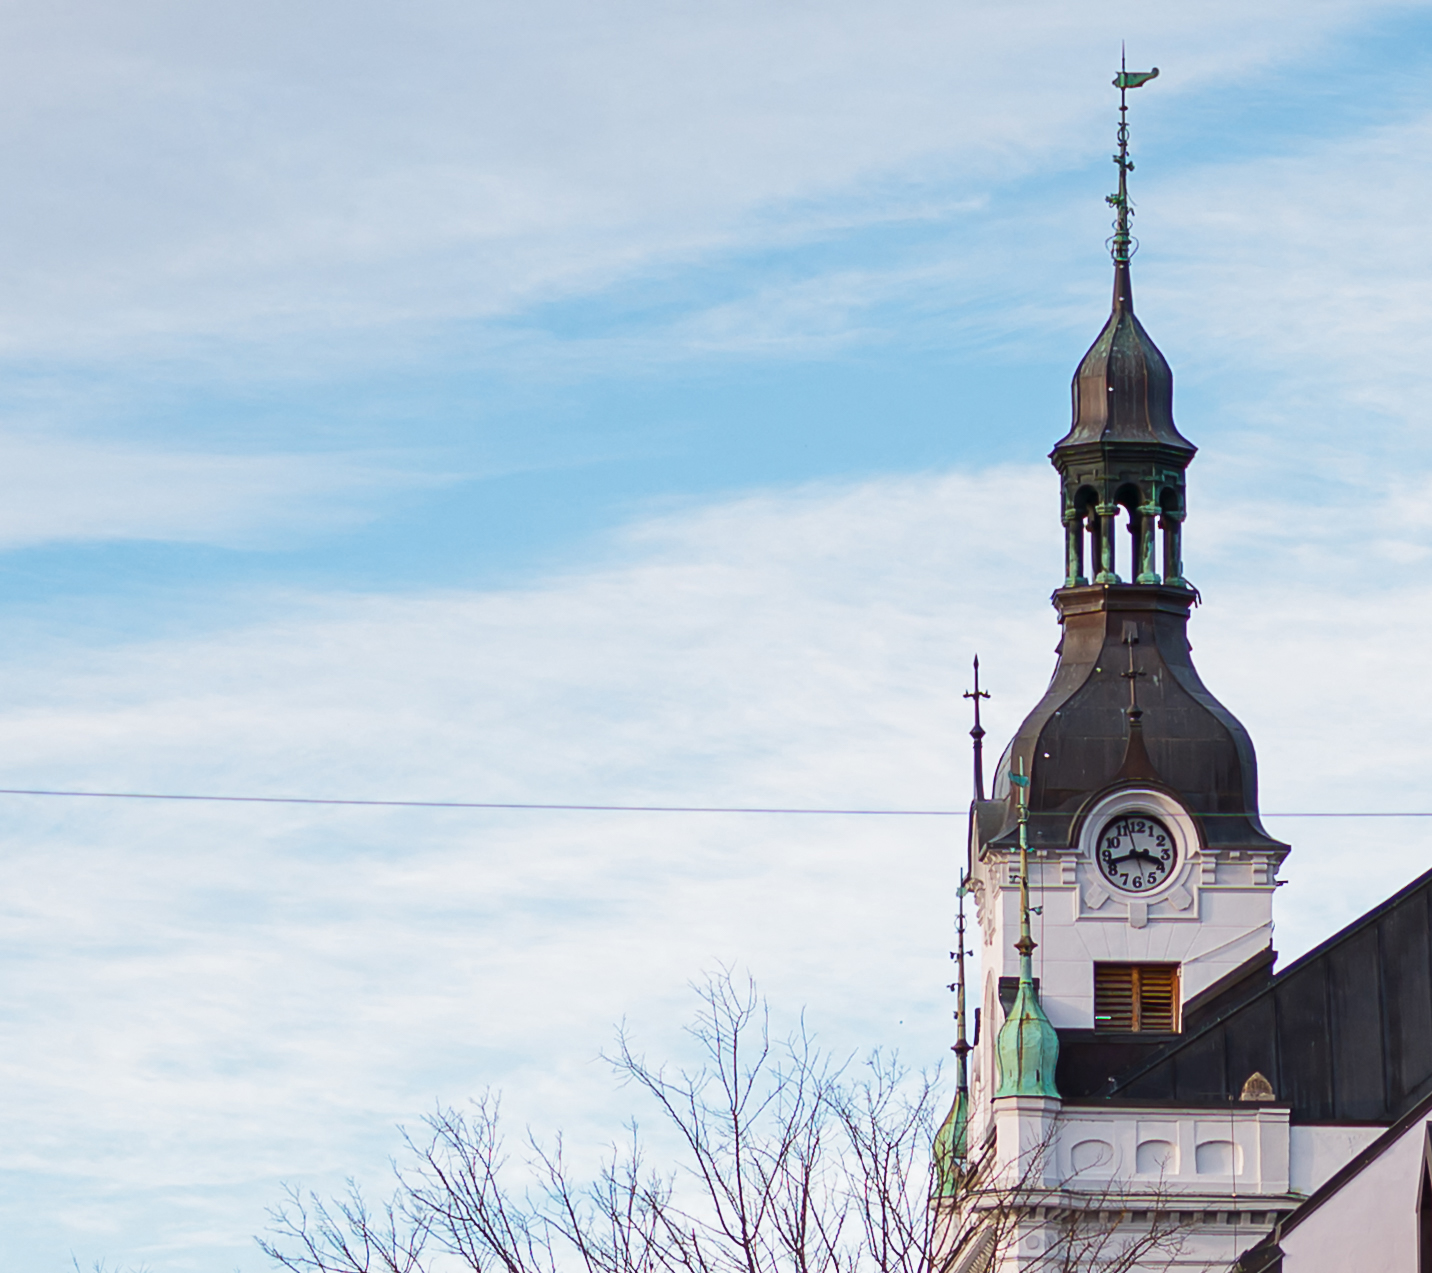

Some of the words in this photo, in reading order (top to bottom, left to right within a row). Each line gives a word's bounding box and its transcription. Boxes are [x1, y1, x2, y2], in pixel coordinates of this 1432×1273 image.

[1130, 821, 1146, 833] 12
[1148, 825, 1154, 837] 1
[1106, 837, 1120, 849] 10
[1156, 835, 1166, 847] 2
[1102, 850, 1112, 862] 9
[1161, 848, 1170, 860] 3
[1156, 862, 1165, 873] 4
[1119, 873, 1129, 886] 7
[1132, 876, 1142, 888] 6
[1147, 871, 1157, 884] 5
